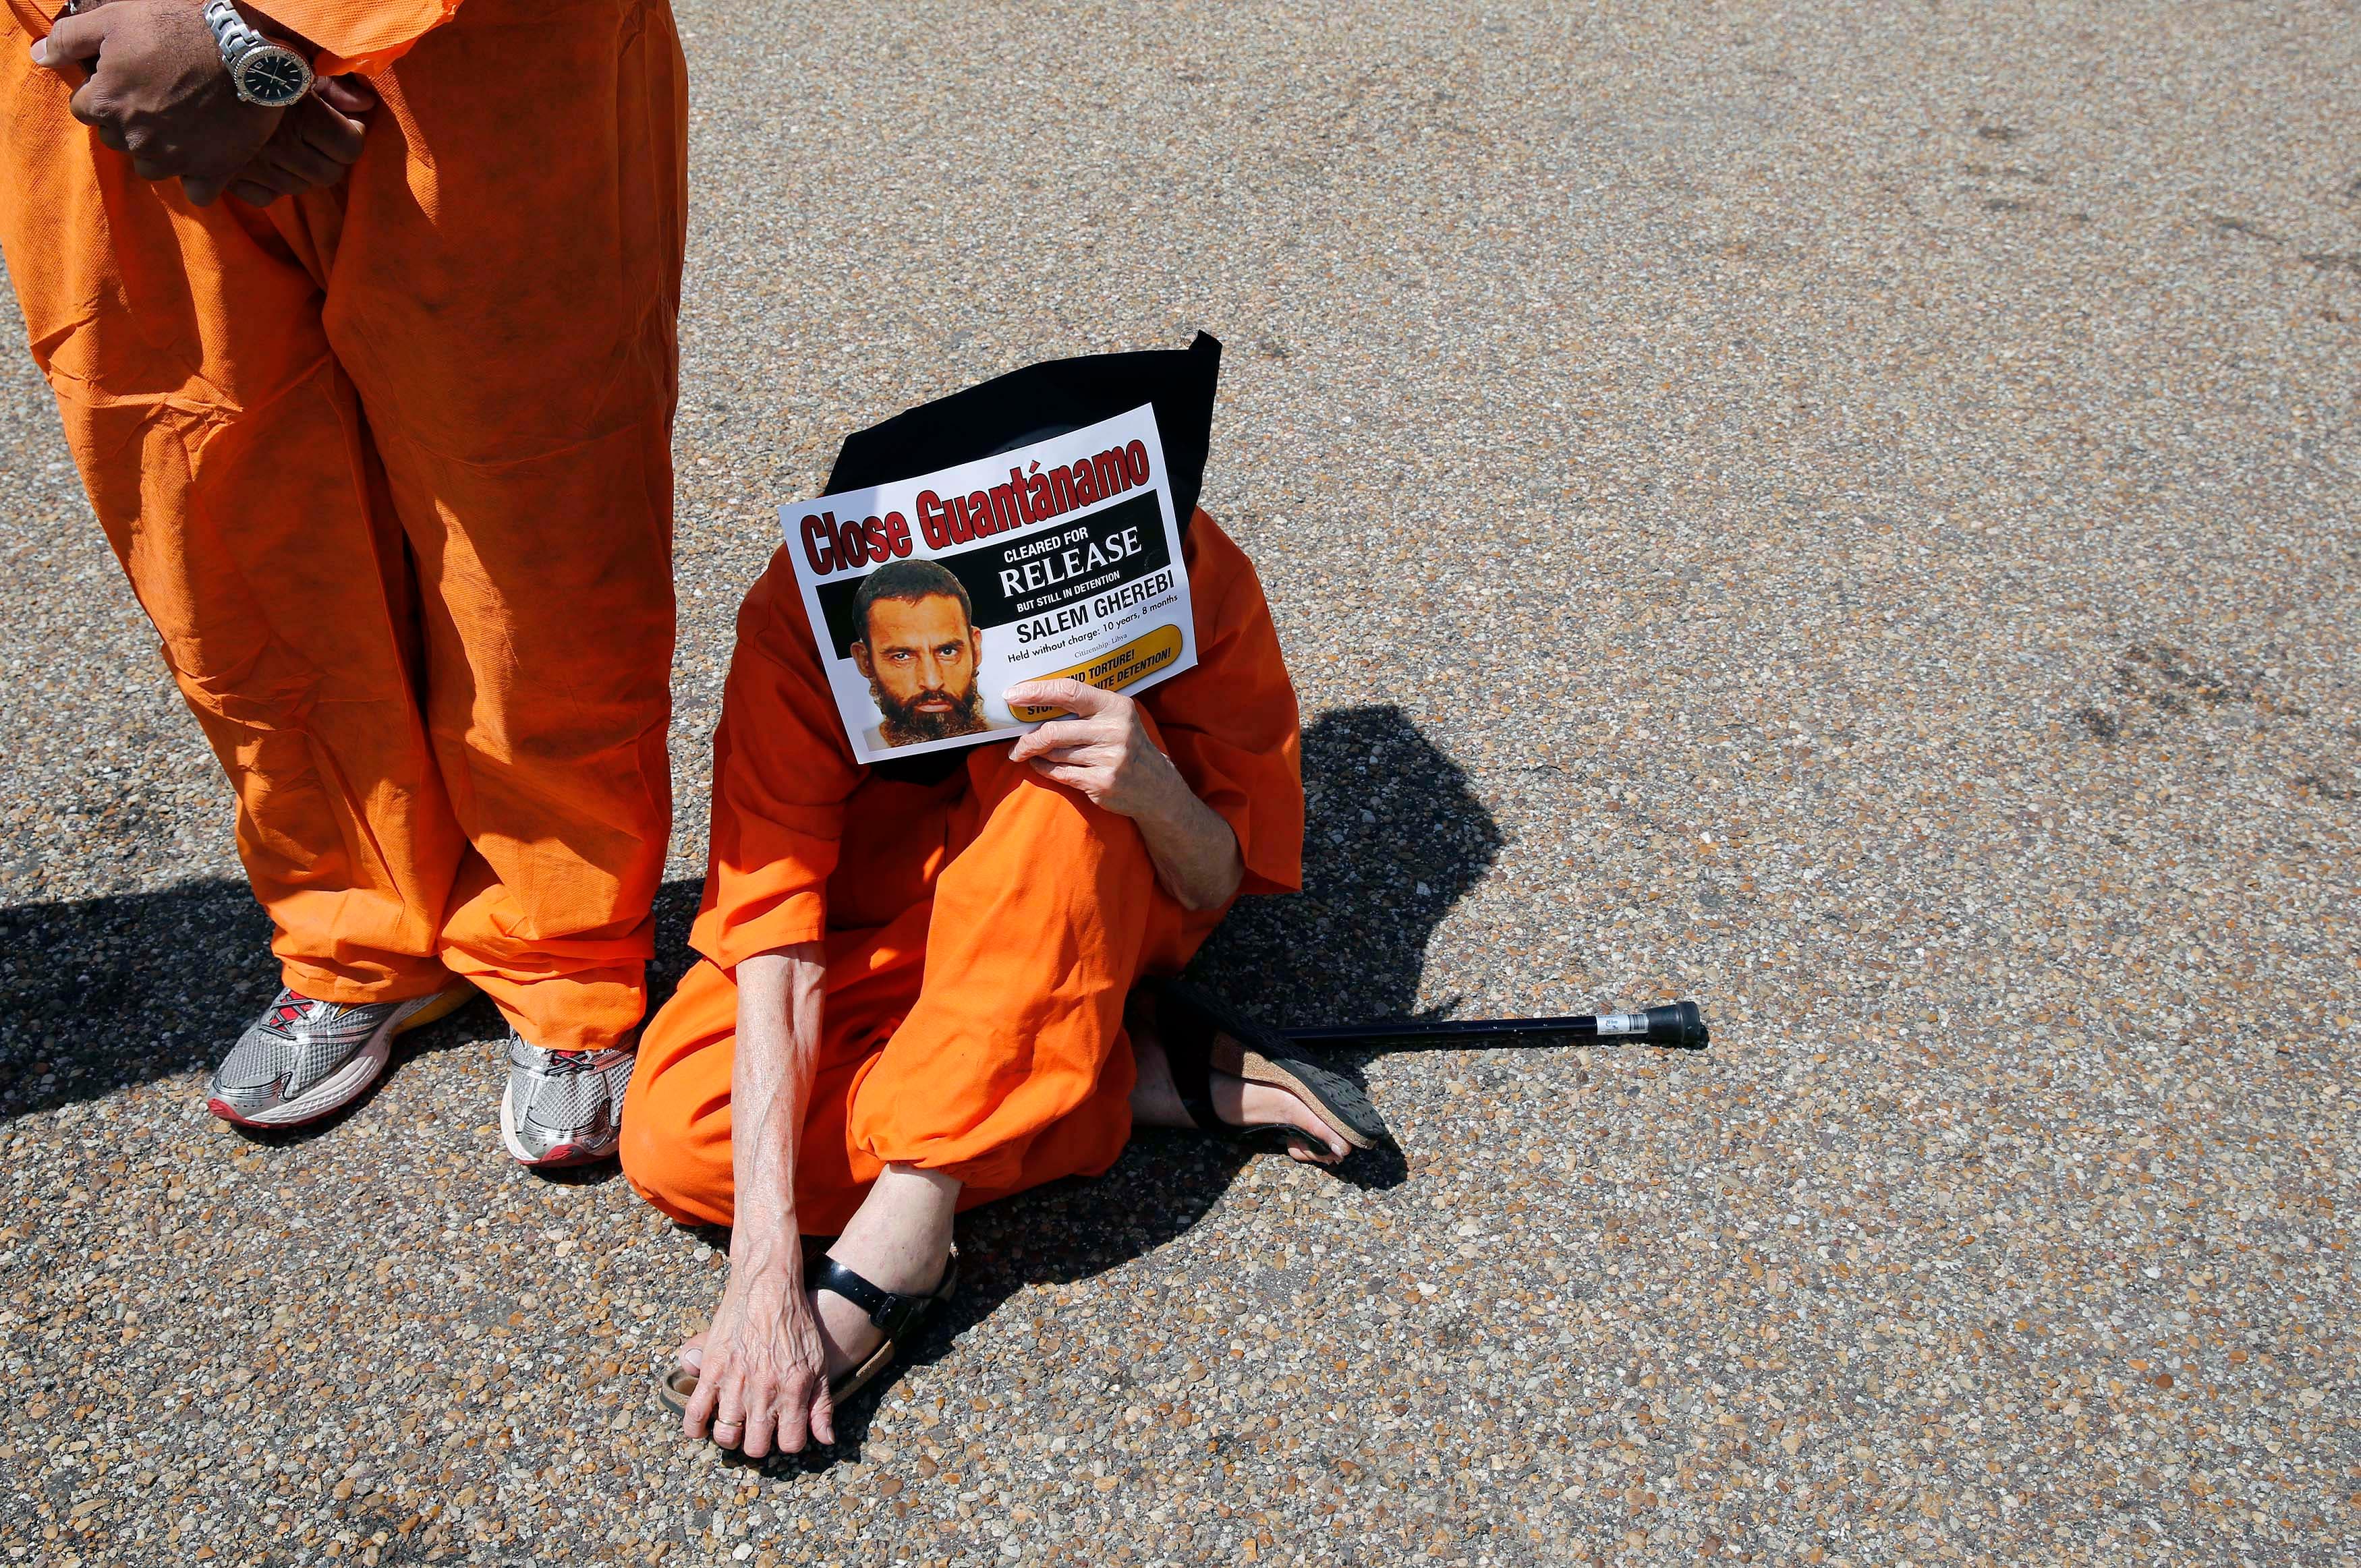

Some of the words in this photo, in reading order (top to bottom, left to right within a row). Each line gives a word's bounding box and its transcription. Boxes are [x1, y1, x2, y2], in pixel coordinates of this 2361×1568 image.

[800, 511, 913, 575] Close
[916, 439, 1150, 550] Guantánamo
[998, 526, 1142, 598] RELEASE
[1004, 536, 1061, 563] CLEARED
[1063, 527, 1089, 545] FOR
[1017, 600, 1035, 612] BUT
[1036, 593, 1062, 607] STILL
[1062, 588, 1073, 599] IN
[1075, 570, 1120, 595] DETENTION
[1017, 604, 1089, 643] SALEM
[1094, 569, 1174, 618] GHEREBI
[1008, 652, 1029, 663] Held
[1031, 640, 1066, 657] without
[1068, 629, 1101, 646] charge:
[1103, 621, 1114, 632] 10
[1116, 613, 1140, 630] years,
[1142, 607, 1148, 615] 8
[1149, 594, 1178, 612] months
[1074, 641, 1112, 659] Citizenship:
[1112, 633, 1128, 645] Libya
[1088, 649, 1135, 680] TORTURE!
[1117, 647, 1171, 683] DETENTION!
